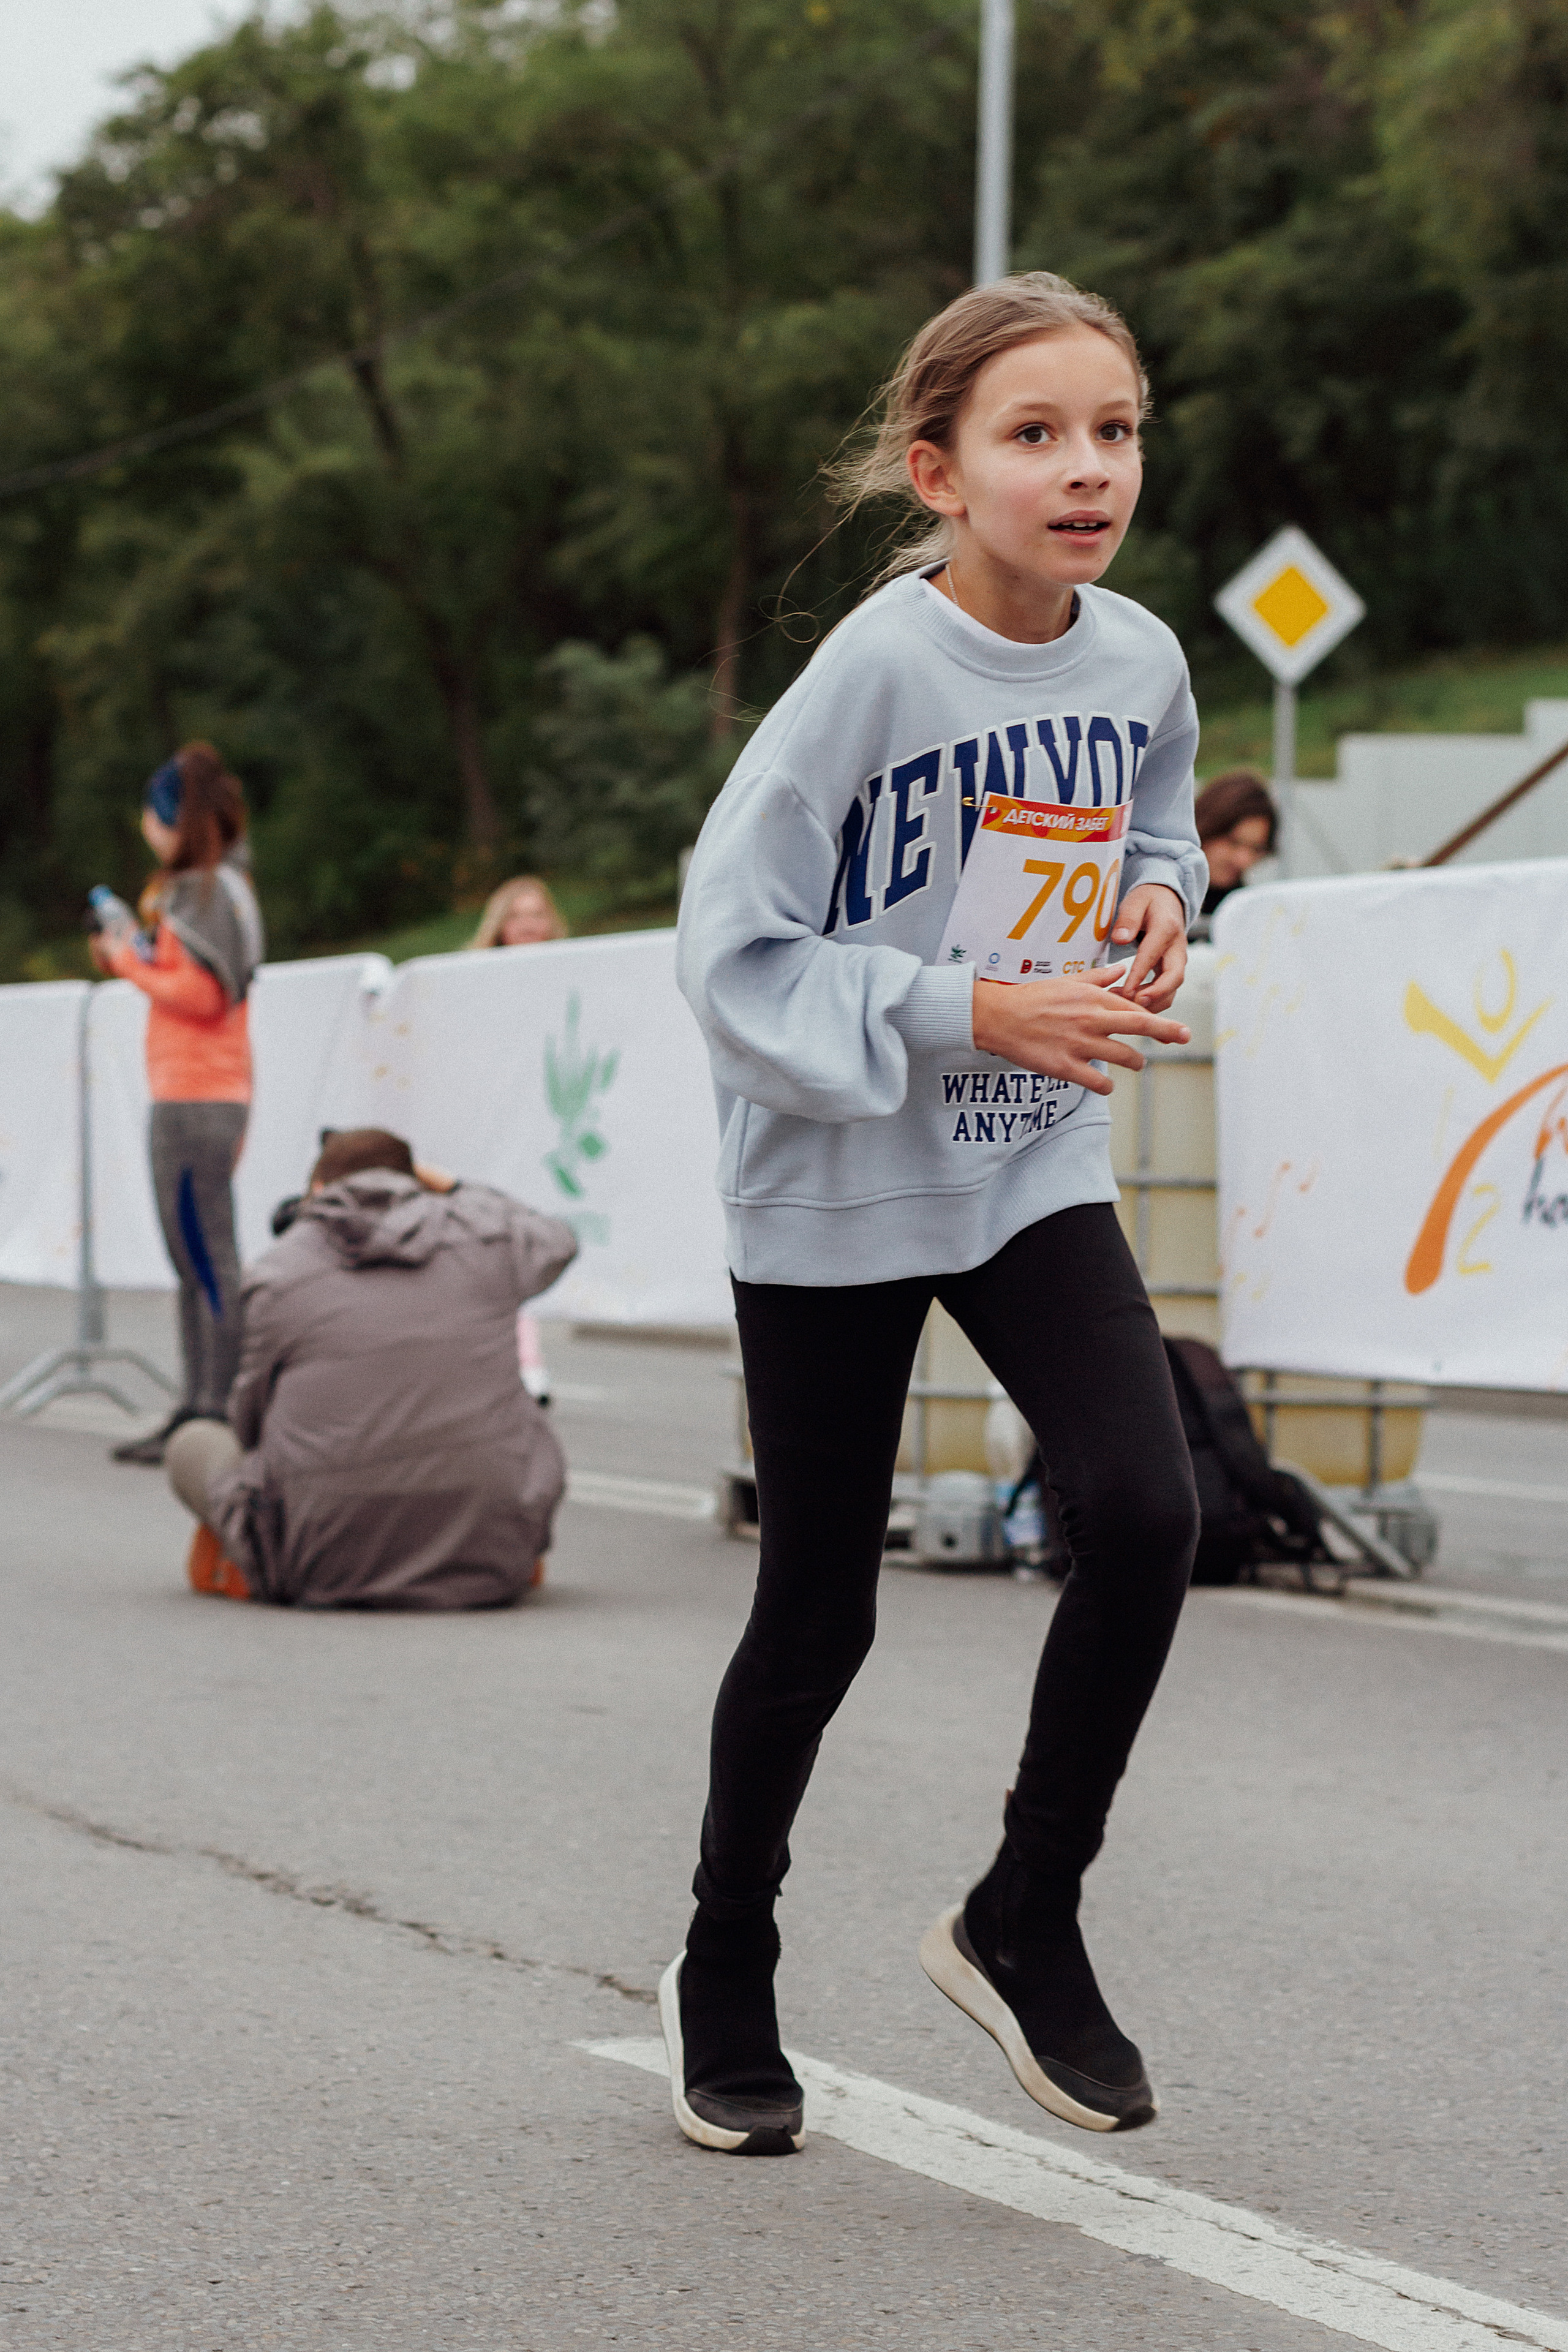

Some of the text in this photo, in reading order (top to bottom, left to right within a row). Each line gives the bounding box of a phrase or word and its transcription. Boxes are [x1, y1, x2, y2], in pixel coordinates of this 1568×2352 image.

[1033, 711, 1150, 806] YO
[1002, 808, 1076, 831] ДЕТСКИЙ
[1006, 858, 1120, 943] 790
[941, 1073, 1070, 1104] WHATE
